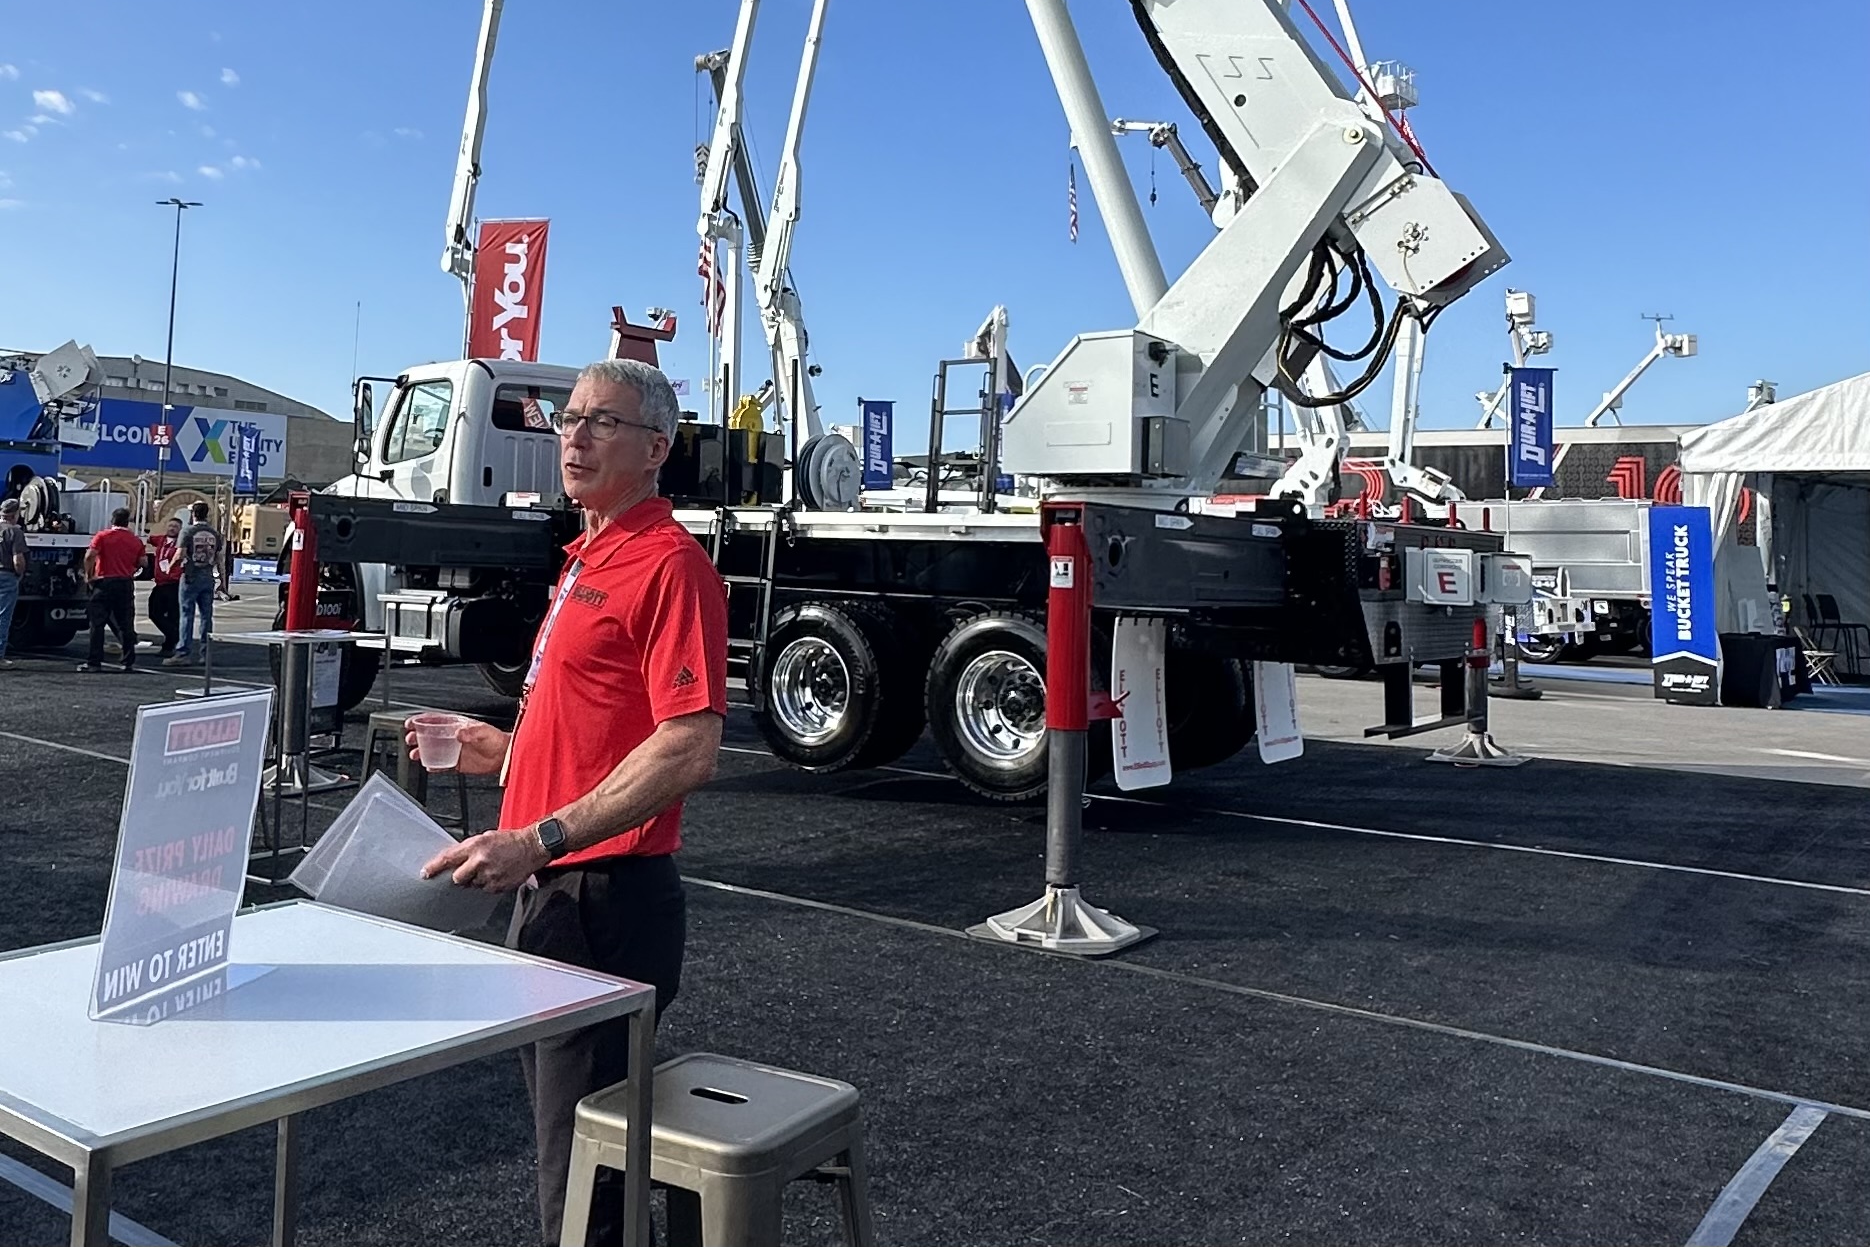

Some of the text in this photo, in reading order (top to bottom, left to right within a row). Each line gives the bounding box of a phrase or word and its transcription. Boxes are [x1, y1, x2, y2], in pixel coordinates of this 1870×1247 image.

[492, 234, 530, 331] You.
[1150, 373, 1159, 397] E
[153, 435, 170, 445] 26
[157, 426, 166, 435] E
[1437, 572, 1458, 594] E
[1665, 552, 1677, 613] WE SPEAK
[1673, 524, 1692, 641] BUCKET TRUCK
[316, 603, 342, 616] D100i
